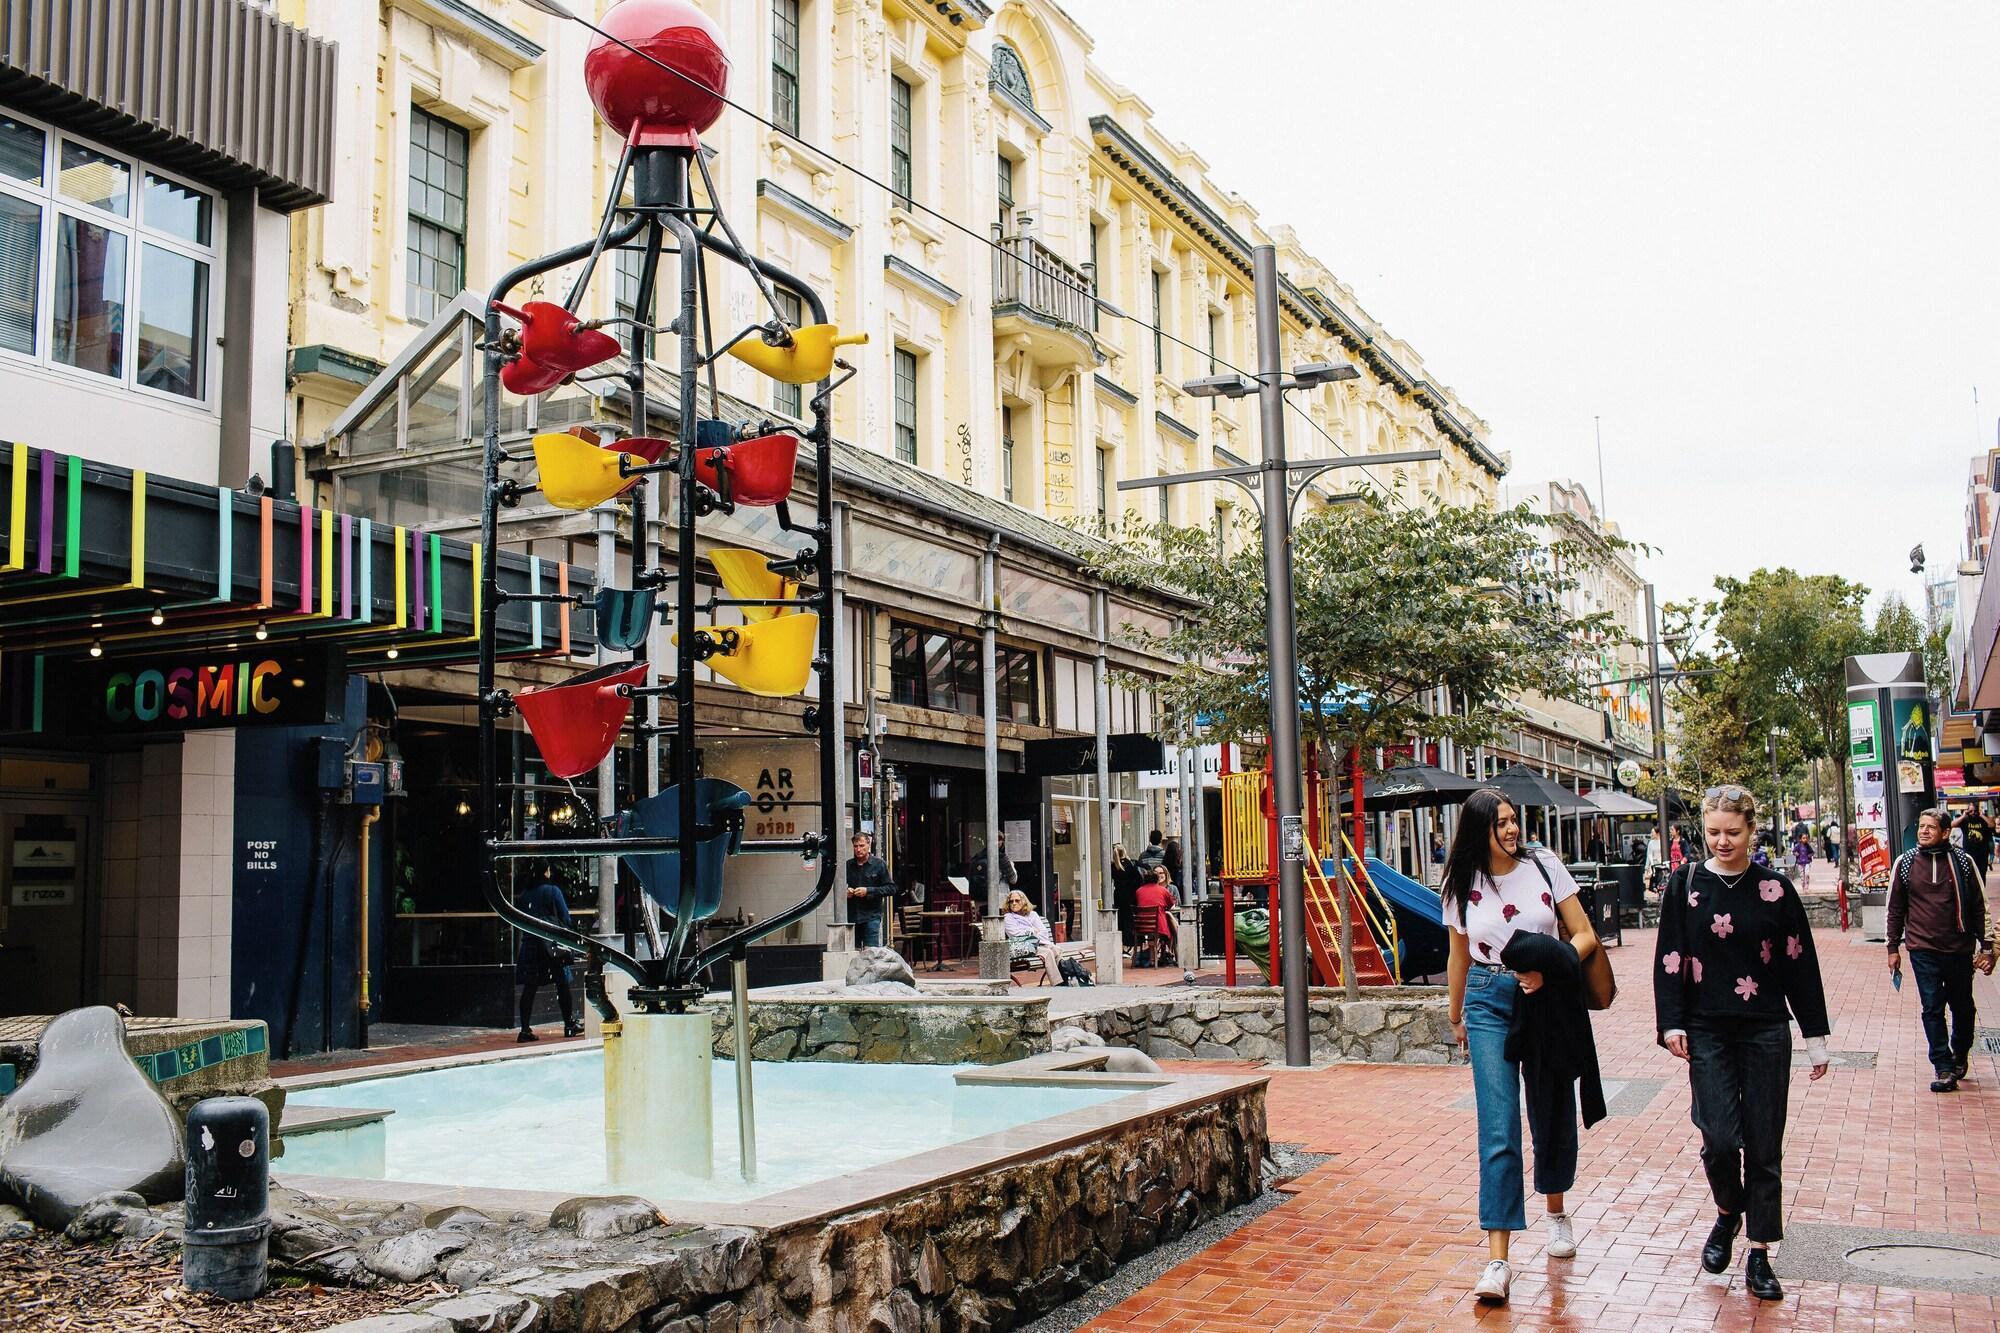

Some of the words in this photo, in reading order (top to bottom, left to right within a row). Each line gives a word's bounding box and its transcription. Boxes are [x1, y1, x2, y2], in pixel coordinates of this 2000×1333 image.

[106, 659, 282, 722] COSMIC
[757, 768, 794, 789] AR
[757, 791, 795, 813] OY
[247, 841, 277, 850] POST
[254, 851, 269, 859] NO
[247, 861, 277, 870] BILLS
